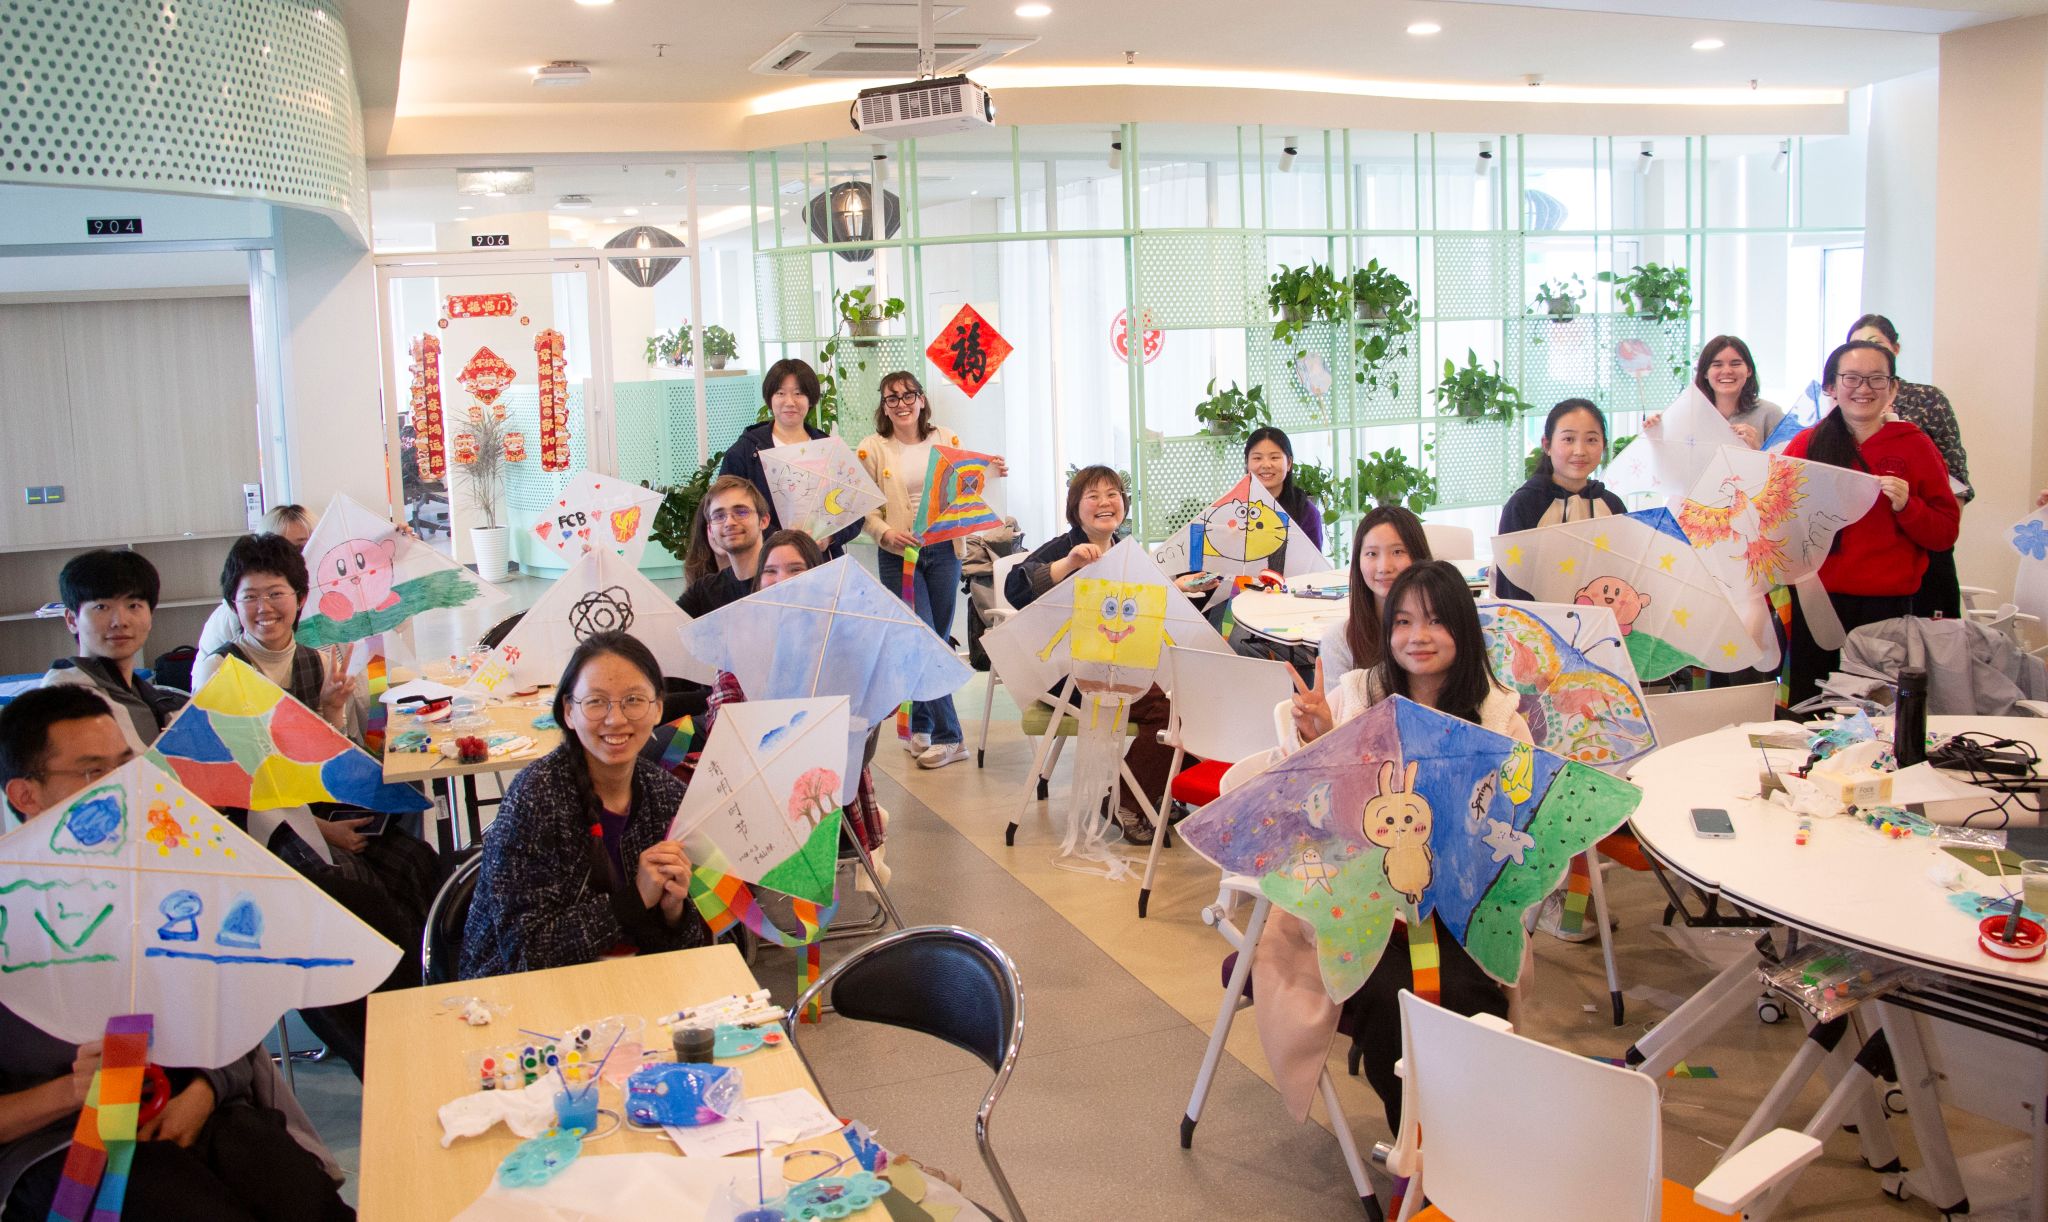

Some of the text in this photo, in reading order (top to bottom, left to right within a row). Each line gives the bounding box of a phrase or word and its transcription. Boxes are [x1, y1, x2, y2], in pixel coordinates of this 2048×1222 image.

[94, 220, 135, 233] 904
[476, 235, 505, 246] 906
[950, 321, 987, 384] 福
[558, 511, 587, 529] FCB
